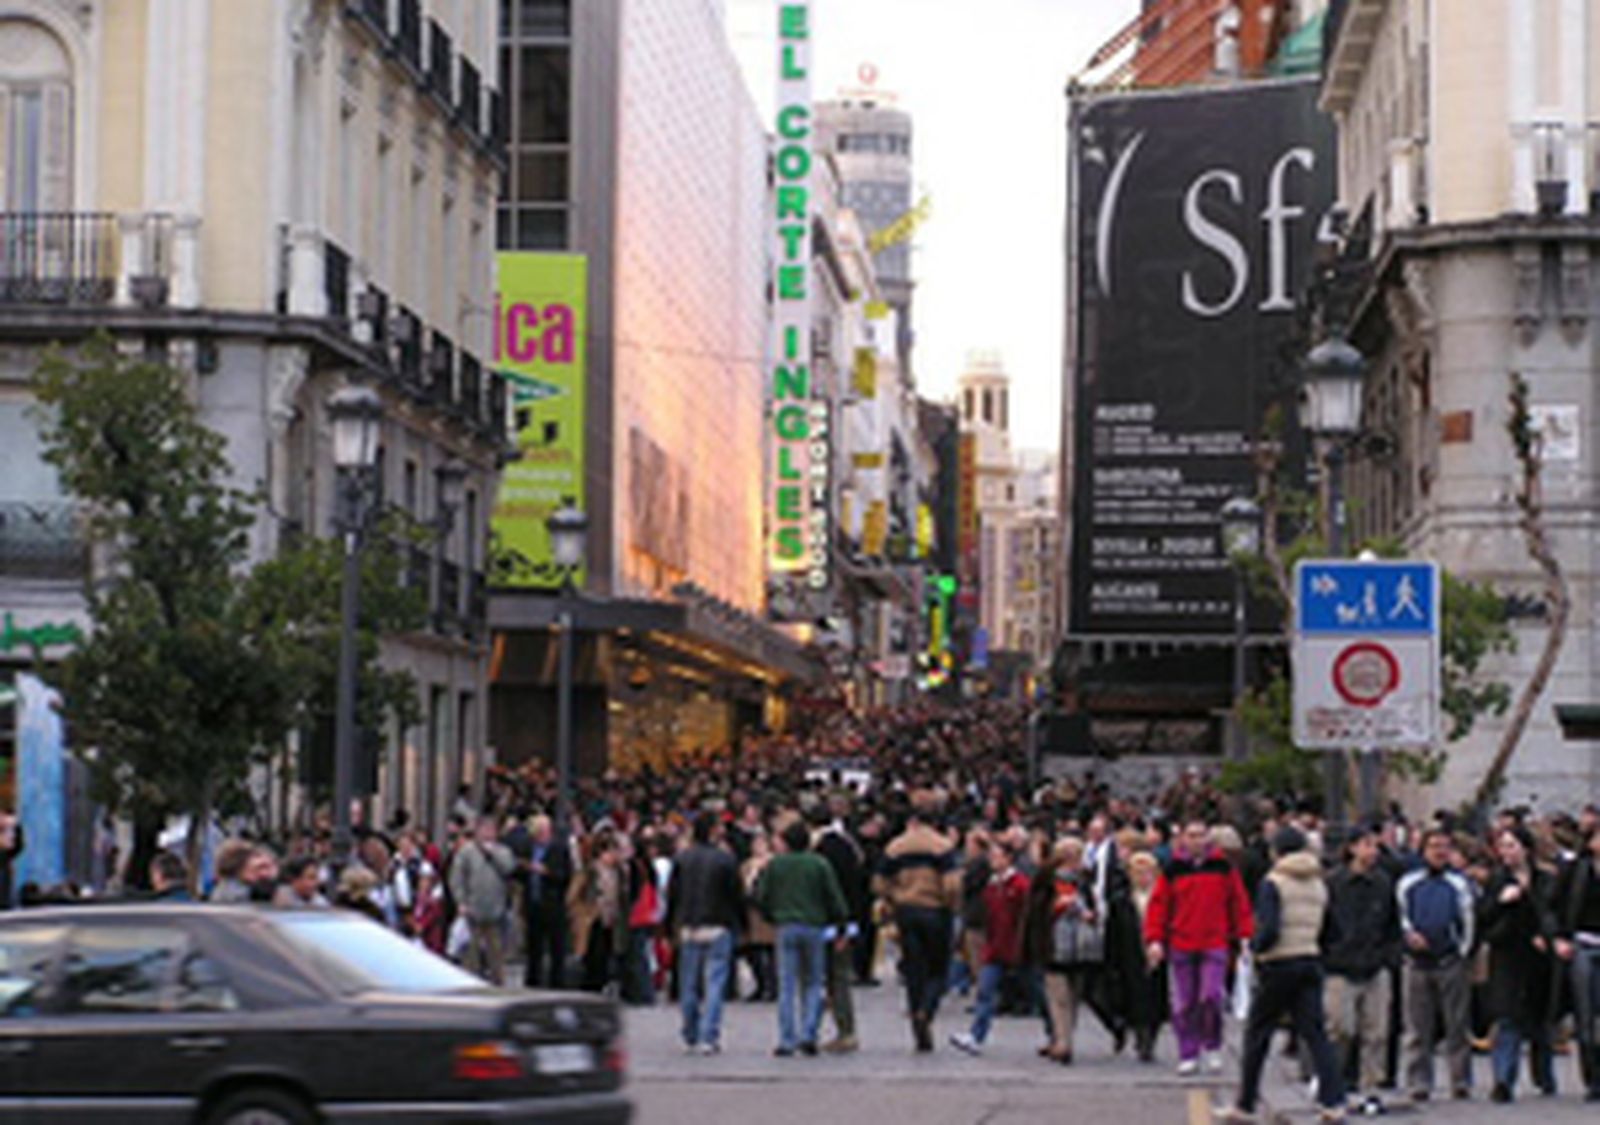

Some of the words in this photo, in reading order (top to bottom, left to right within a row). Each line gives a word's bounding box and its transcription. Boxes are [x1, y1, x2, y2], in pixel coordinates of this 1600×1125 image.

[778, 5, 809, 80] EL
[776, 105, 811, 300] CORTE
[773, 325, 811, 561] INGLES
